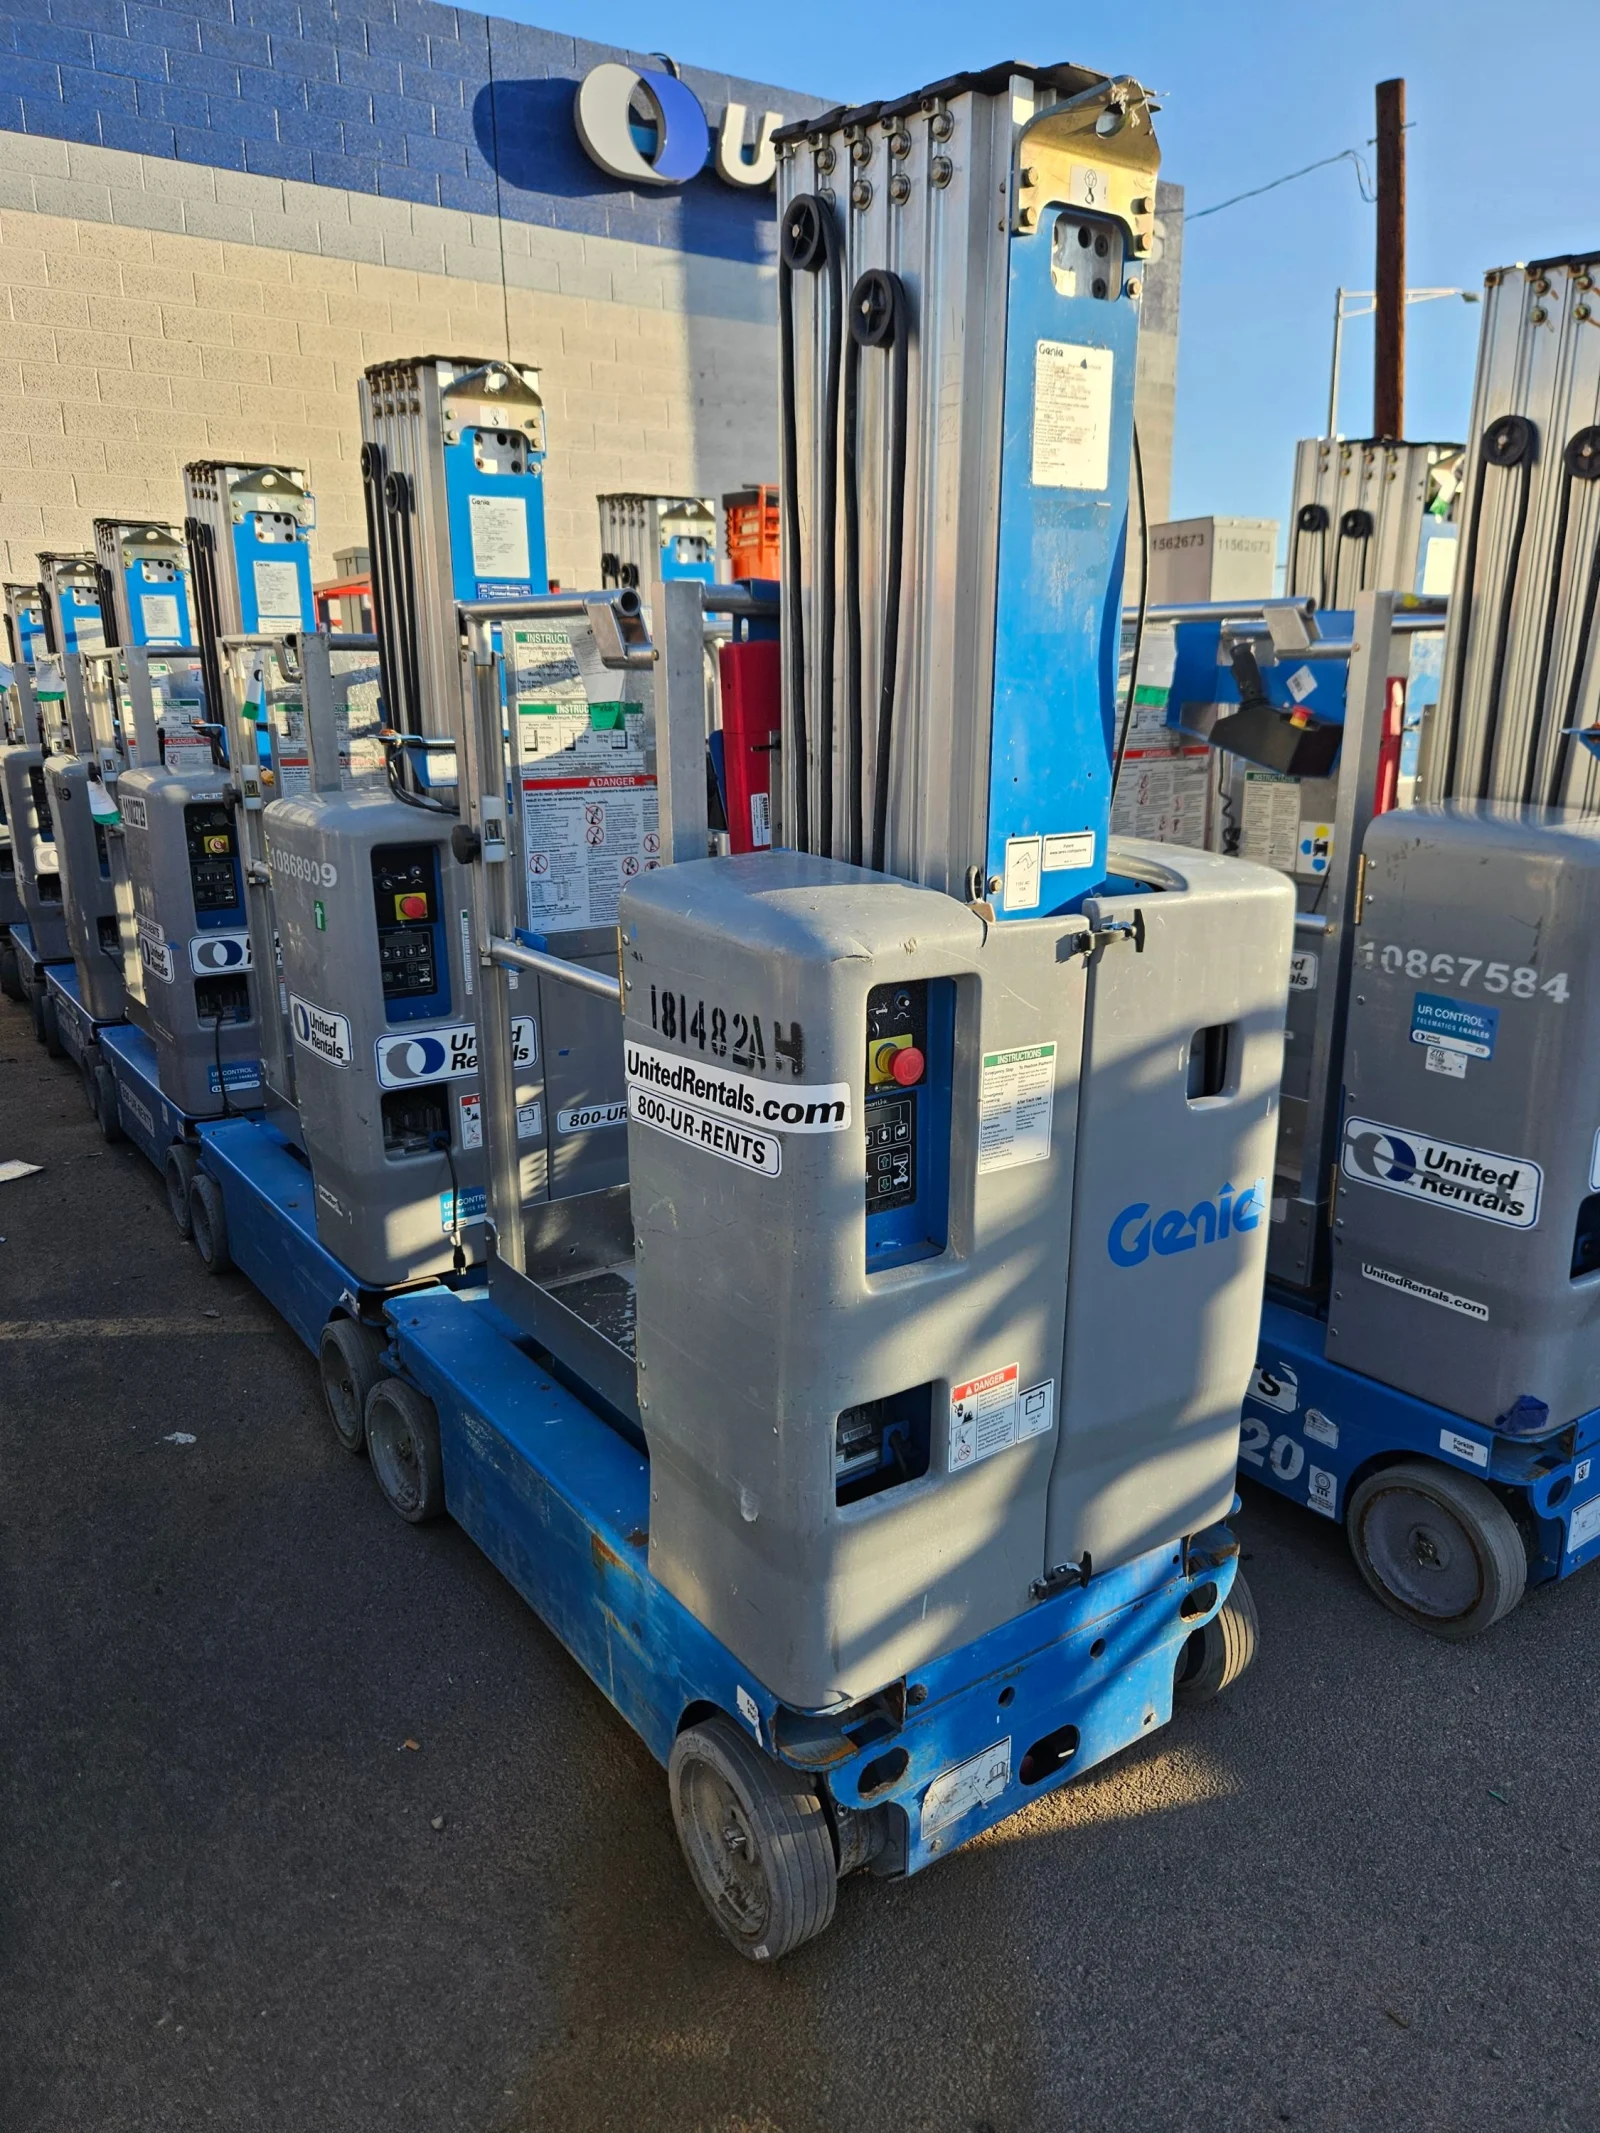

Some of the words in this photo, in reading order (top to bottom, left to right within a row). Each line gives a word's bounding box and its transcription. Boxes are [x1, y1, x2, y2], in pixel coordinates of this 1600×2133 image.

[1038, 343, 1064, 358] Genie
[471, 498, 490, 506] Genie
[527, 633, 570, 643] INSTRUCTI
[556, 705, 589, 714] INSTRUC
[597, 777, 635, 787] DANGER
[1358, 941, 1571, 1004] 10867584
[309, 1011, 337, 1039] United
[1417, 1004, 1433, 1016] UR
[1434, 1008, 1484, 1028] CONTROL
[451, 1025, 522, 1051] Und
[1416, 1016, 1457, 1031] TELEMATICS
[1458, 1026, 1490, 1039] ENABLED
[311, 1030, 344, 1059] Rentals
[1429, 1049, 1445, 1058] ZTR
[451, 1044, 529, 1070] Rels
[997, 1049, 1042, 1065] INSTRUCTIONS
[222, 1067, 253, 1076] CONTROL
[627, 1049, 845, 1125] UnitedRentals.com
[865, 1099, 888, 1108] martLink
[569, 1106, 627, 1127] 800-UR
[982, 1123, 1001, 1131] Operation
[638, 1095, 766, 1165] 800-UR-RENTS
[1424, 1147, 1520, 1191] United
[1419, 1170, 1525, 1217] Rentals
[1107, 1178, 1265, 1267] Genie
[1364, 1264, 1487, 1317] UnitedRentals.com
[974, 1373, 1005, 1392] DANGER
[1453, 1438, 1475, 1452] Forklift
[1453, 1444, 1474, 1458] Pocket
